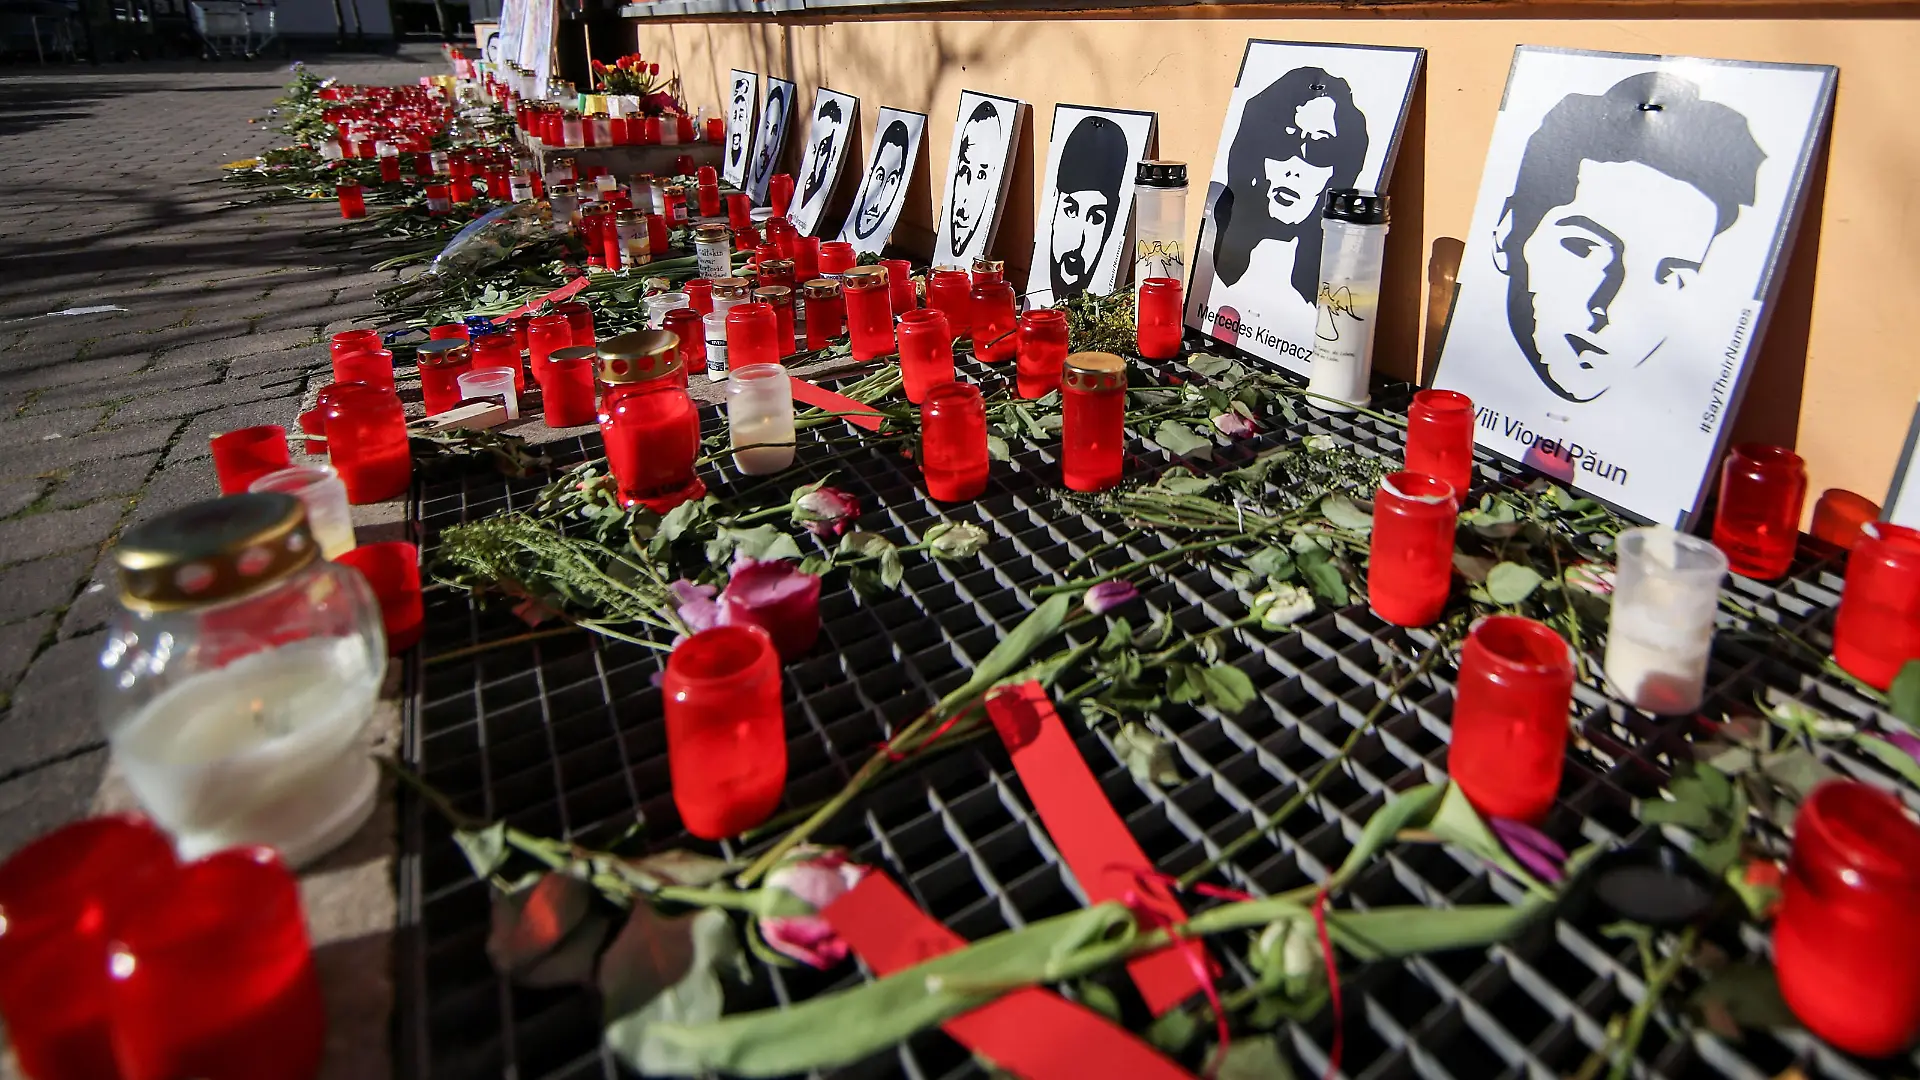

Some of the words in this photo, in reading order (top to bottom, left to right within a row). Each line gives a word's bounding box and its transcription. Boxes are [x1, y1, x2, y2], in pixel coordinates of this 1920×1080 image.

[1197, 303, 1253, 339] Mercedes
[1255, 327, 1313, 363] Kierpacz
[1699, 308, 1752, 434] #SayTheirNames
[1505, 415, 1563, 458] Viorel
[1566, 442, 1628, 486] Păun
